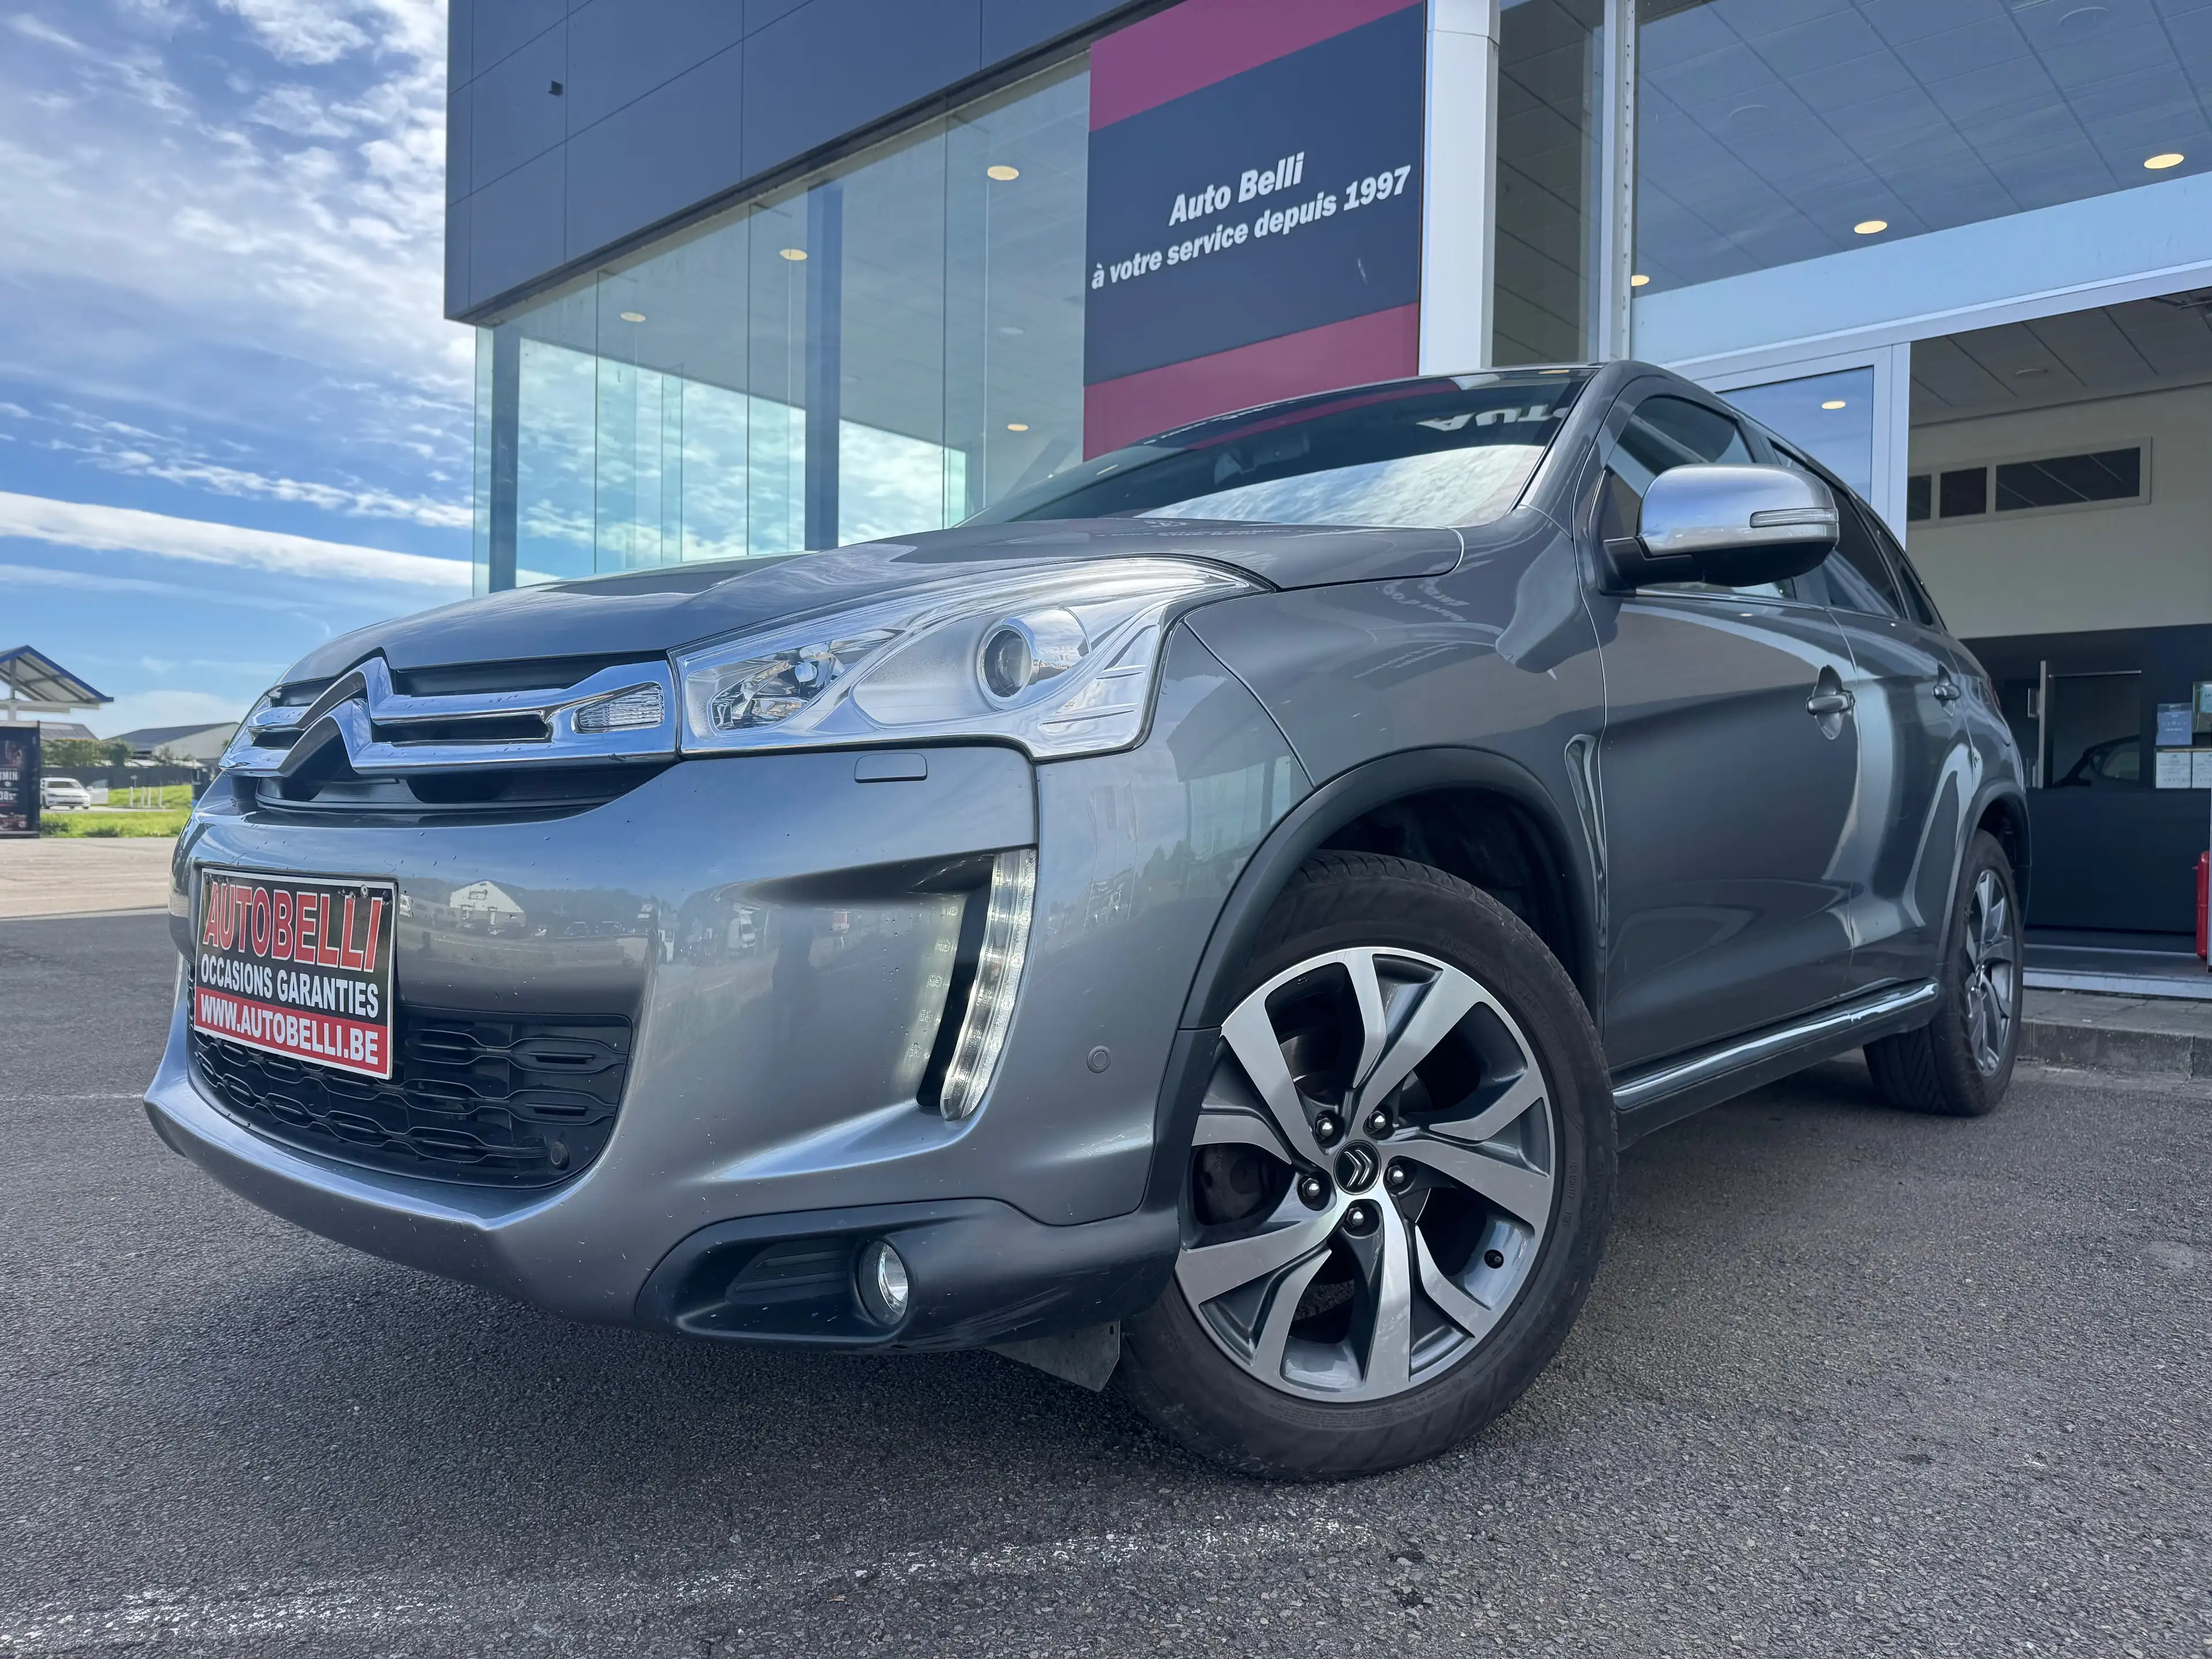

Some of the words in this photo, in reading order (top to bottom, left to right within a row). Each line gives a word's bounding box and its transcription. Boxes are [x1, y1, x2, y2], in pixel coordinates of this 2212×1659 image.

[1168, 183, 1232, 226] Auto
[1237, 151, 1305, 203] Belli
[1091, 263, 1105, 289] à
[1109, 250, 1162, 285] votre
[1166, 224, 1248, 267] service
[1253, 191, 1337, 238] depuis
[1343, 165, 1411, 211] 1997
[202, 881, 384, 974] AUTOBELLI
[200, 953, 273, 999] OCCASIONS
[277, 969, 379, 1018] GARANTIES
[200, 994, 378, 1066] WWW.AUTOBELLI.BE
